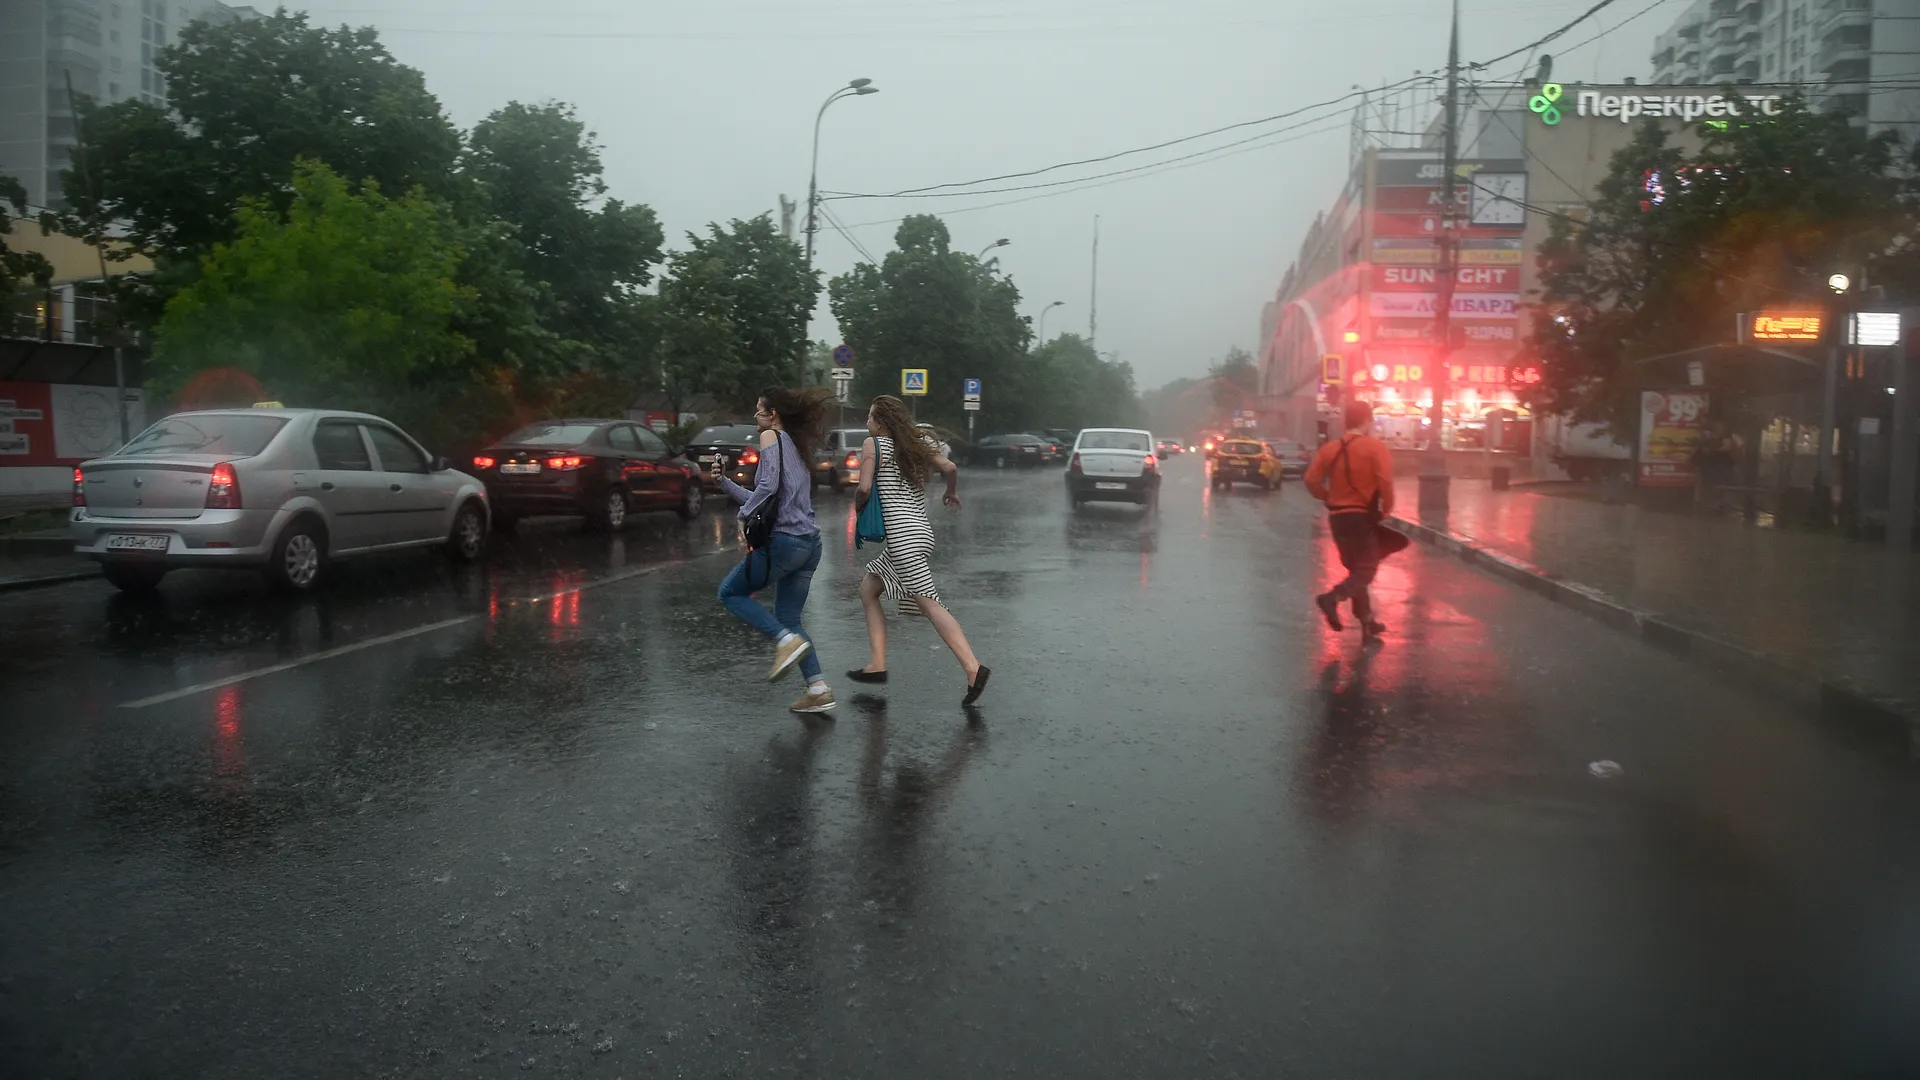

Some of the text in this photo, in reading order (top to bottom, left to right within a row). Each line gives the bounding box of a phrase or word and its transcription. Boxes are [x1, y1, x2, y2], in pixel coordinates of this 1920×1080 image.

[1384, 267, 1507, 284] SUNGHT
[1393, 363, 1464, 384] ДОР
[968, 380, 977, 393] P
